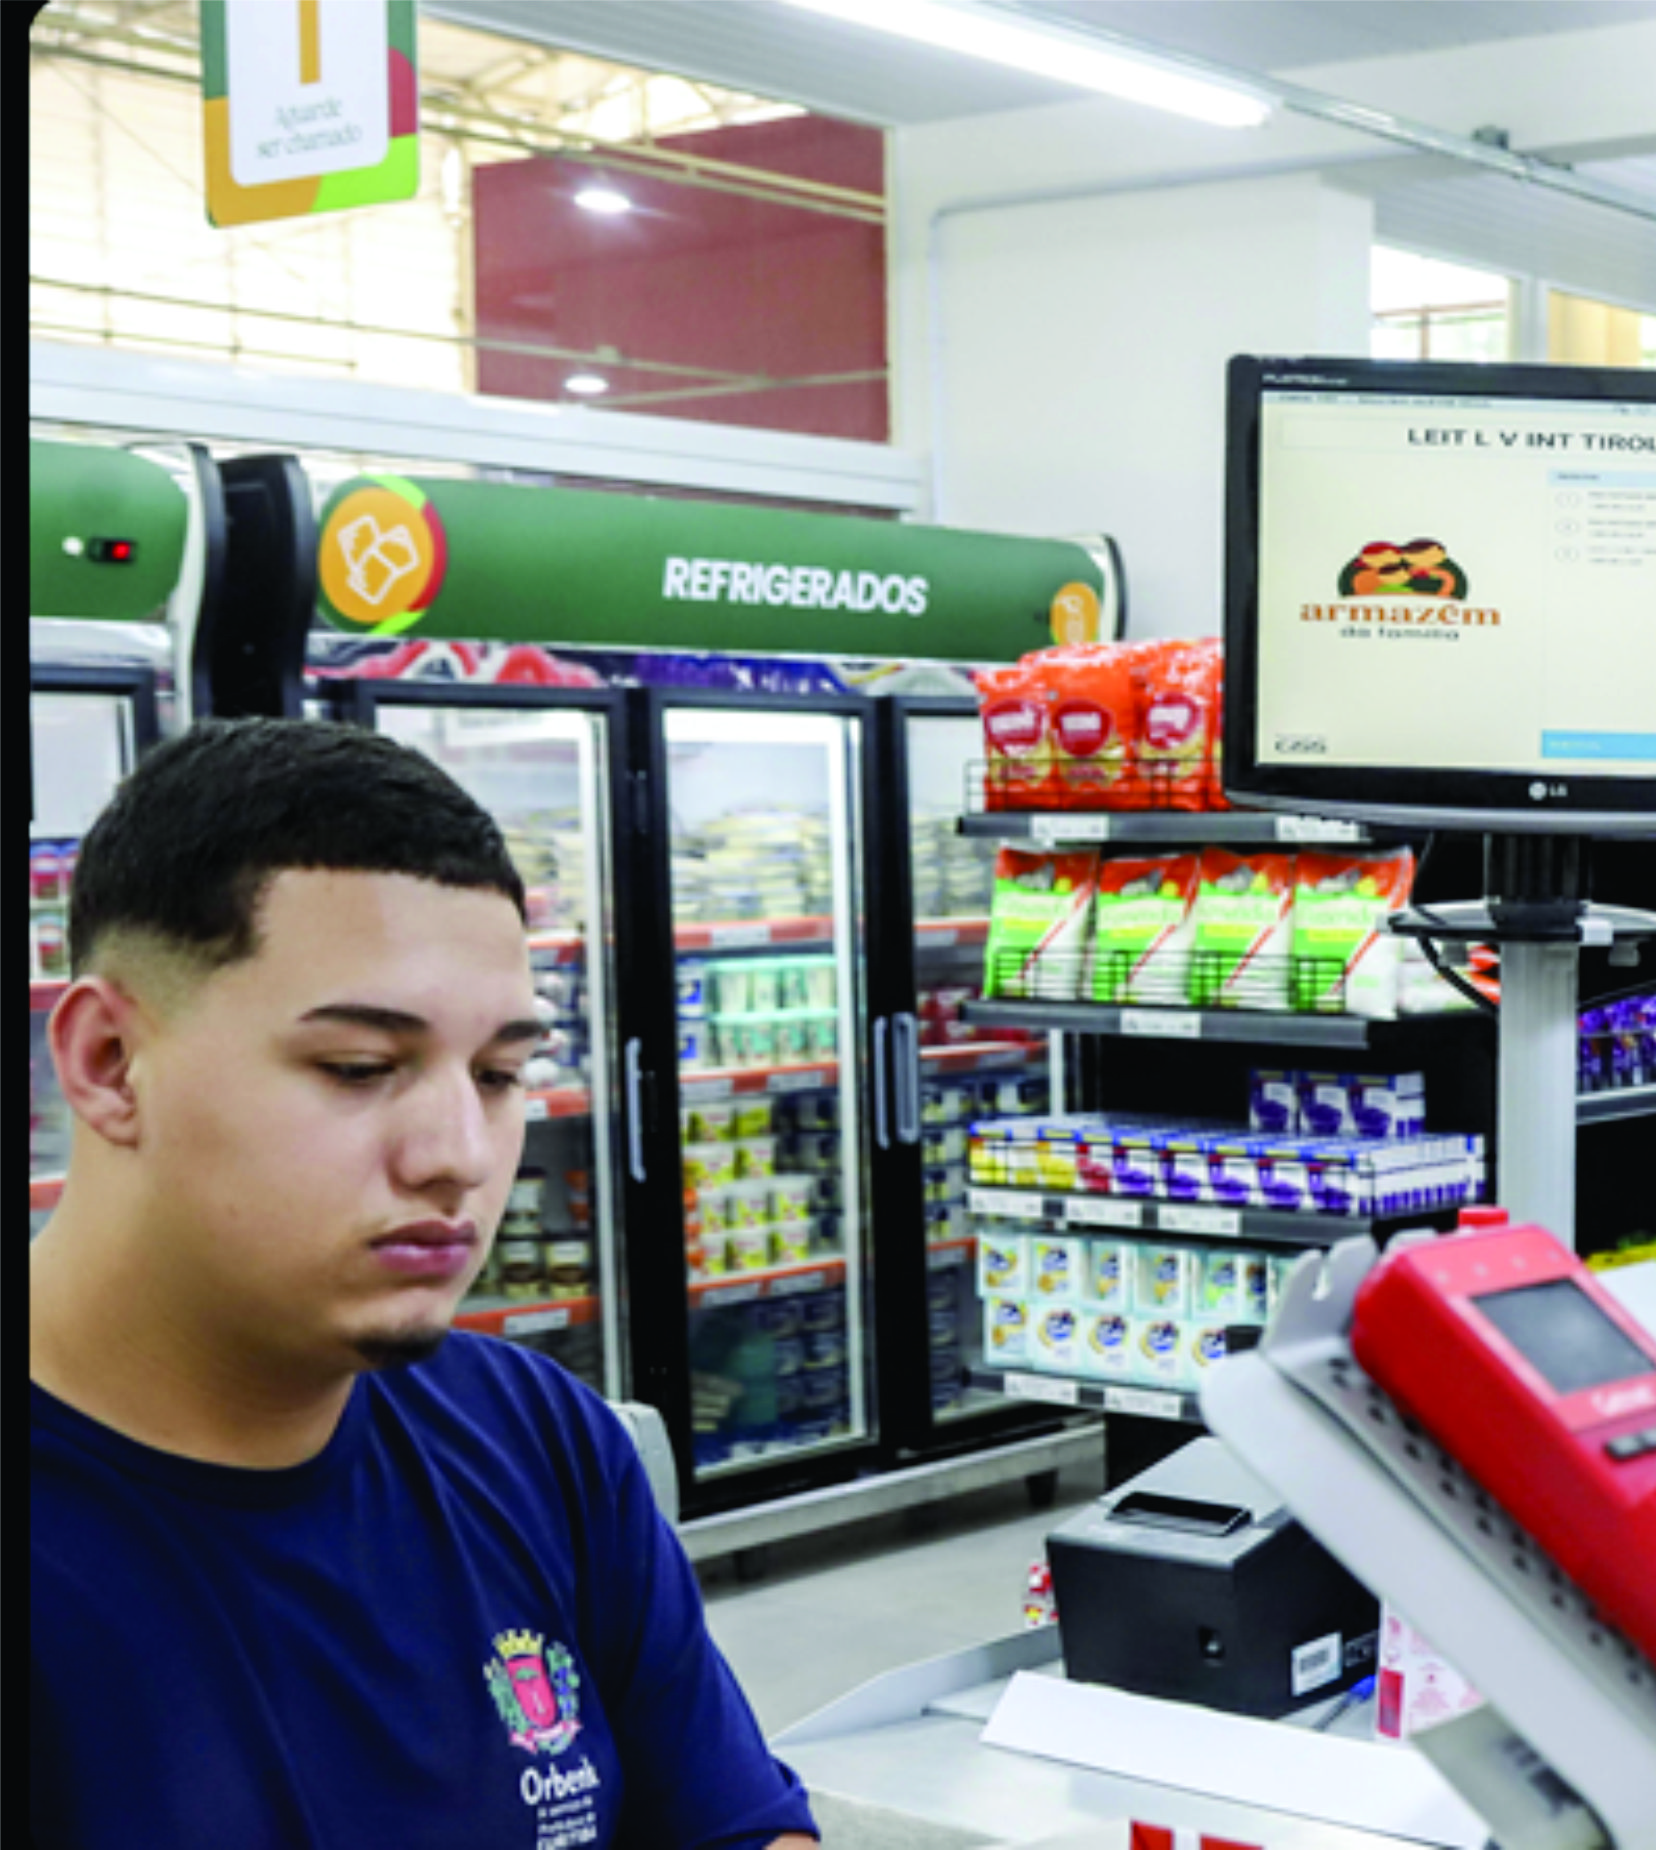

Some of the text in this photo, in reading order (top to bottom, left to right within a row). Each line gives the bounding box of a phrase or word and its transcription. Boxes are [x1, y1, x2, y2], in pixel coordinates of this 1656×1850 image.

[1408, 428, 1468, 446] LEIT
[1475, 430, 1490, 447] L
[1499, 431, 1518, 448] V
[1525, 433, 1573, 449] INT
[663, 556, 928, 616] REFRIGERADOS
